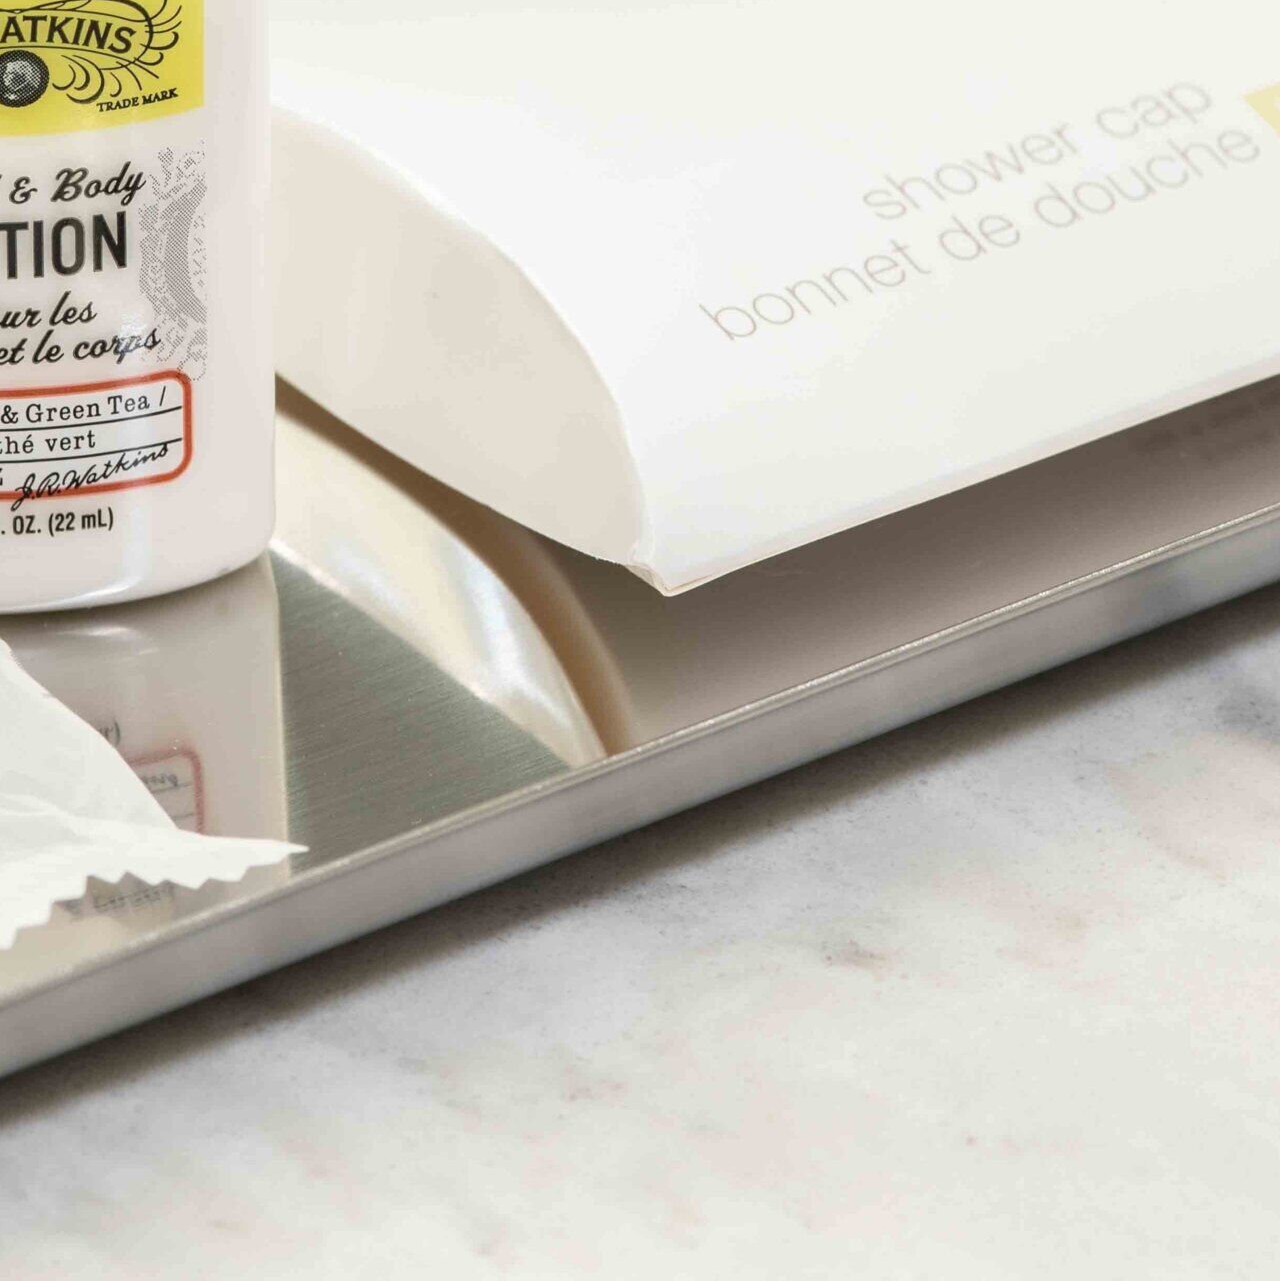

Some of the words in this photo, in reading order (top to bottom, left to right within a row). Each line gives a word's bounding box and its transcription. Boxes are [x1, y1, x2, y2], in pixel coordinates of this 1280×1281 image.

[96, 96, 140, 114] TRADE
[141, 87, 179, 107] MARK
[862, 124, 1080, 222] shower
[1095, 81, 1214, 142] cap
[9, 176, 38, 204] &
[51, 161, 147, 206] Body
[699, 239, 933, 343] bonnet
[938, 213, 1023, 263] de
[1033, 128, 1262, 230] douche
[50, 290, 97, 327] les
[31, 329, 64, 362] le
[72, 326, 162, 366] corps
[0, 404, 20, 424] &
[25, 402, 102, 423] Green
[107, 395, 150, 416] Tea
[158, 386, 168, 408] /
[45, 430, 97, 453] vert
[12, 515, 42, 536] OZ.
[49, 511, 75, 538] (22
[81, 507, 114, 532] mL)
